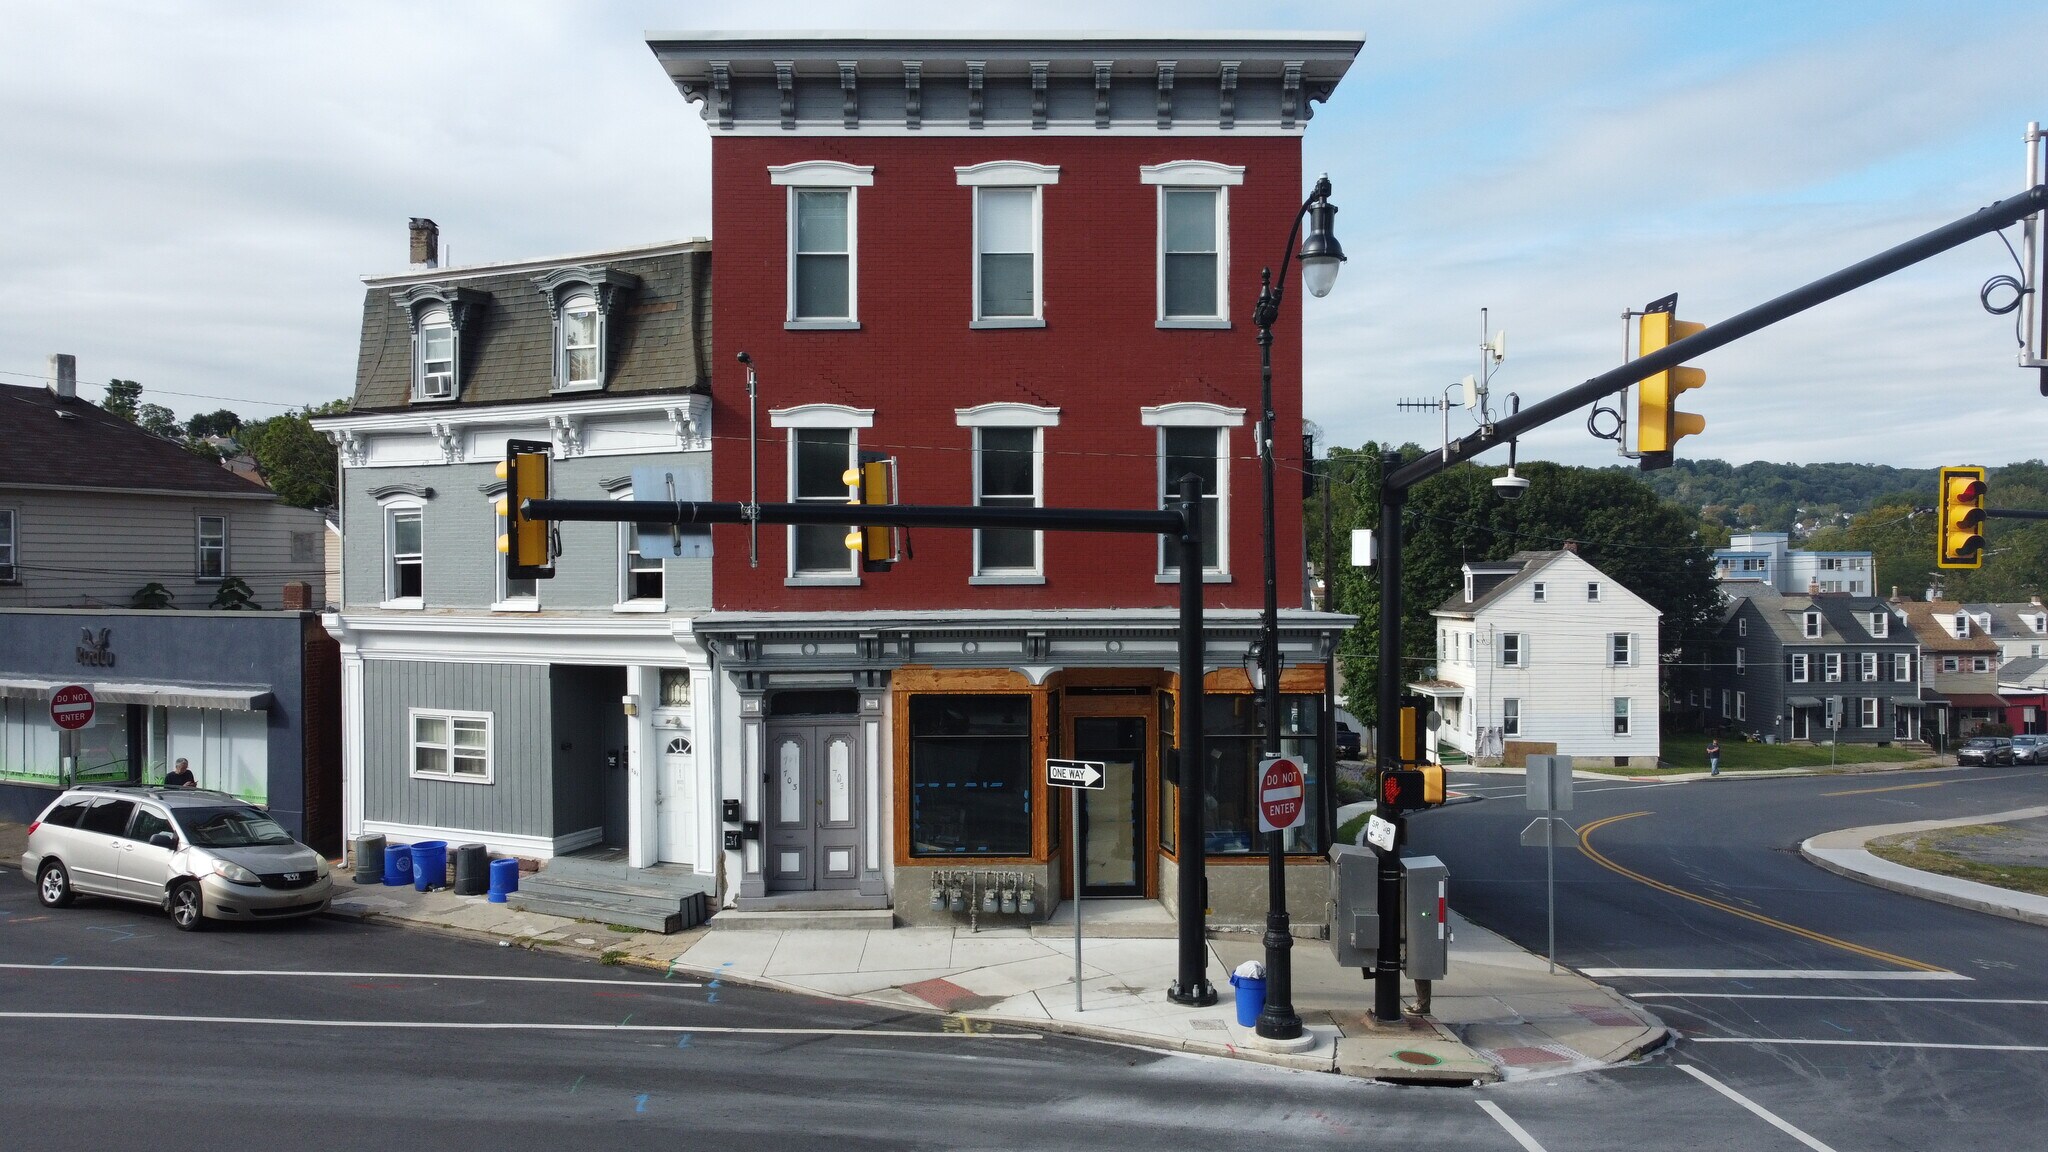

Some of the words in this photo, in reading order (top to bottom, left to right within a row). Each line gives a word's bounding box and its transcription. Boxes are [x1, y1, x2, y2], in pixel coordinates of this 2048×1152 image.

[72, 693, 87, 701] NOT
[60, 713, 85, 722] ENTER
[1052, 768, 1067, 778] ONE
[1069, 769, 1085, 780] WAY
[1266, 774, 1278, 786] DO
[1282, 771, 1297, 784] NOT
[1269, 802, 1295, 817] ENTER
